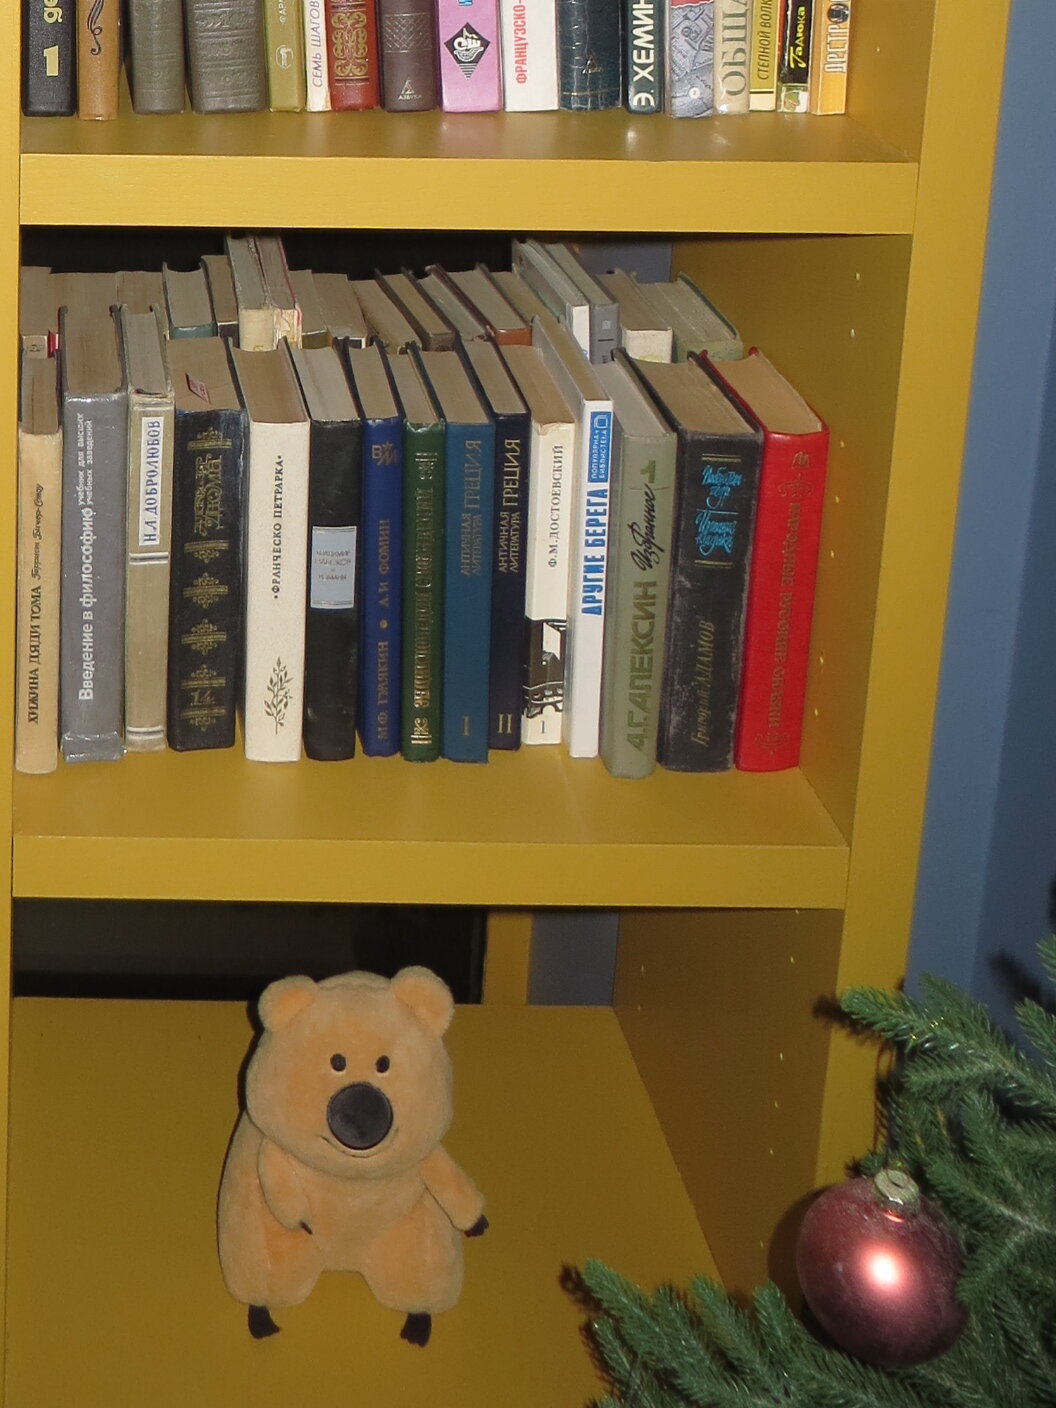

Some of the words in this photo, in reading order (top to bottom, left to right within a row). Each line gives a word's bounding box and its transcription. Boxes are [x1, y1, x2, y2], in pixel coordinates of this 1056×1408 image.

[308, 0, 322, 48] ШАГОВ
[788, 6, 807, 69] Гадюка
[310, 53, 324, 88] СЕМЬ
[755, 30, 771, 81] СТЕПНОЙ
[631, 88, 655, 107] Э.
[76, 450, 85, 468] для
[83, 420, 94, 466] заведений
[502, 439, 521, 508] ГРЕЦИЯ
[640, 460, 657, 485] 1
[143, 420, 161, 543] Н.А.ДОБРОЛЮБОВ
[463, 440, 484, 510] ГРЕЦИЯ
[459, 513, 472, 576] АНТИЧНАЯ
[470, 514, 483, 576] ЛИТЕРАТУРА
[497, 511, 511, 573] АНТИЧНАЯ
[508, 511, 521, 573] ЛИТЕРАТУРА
[582, 488, 609, 549] БЕРЕГА
[78, 507, 98, 609] философию
[580, 554, 605, 616] ДРУГИЕ
[29, 585, 42, 623] ТОМА
[83, 610, 94, 621] в
[27, 624, 42, 665] ДЯДИ
[77, 623, 96, 701] Введение
[694, 620, 715, 687] АДАМОВ
[27, 667, 41, 725] ХИЖИНА
